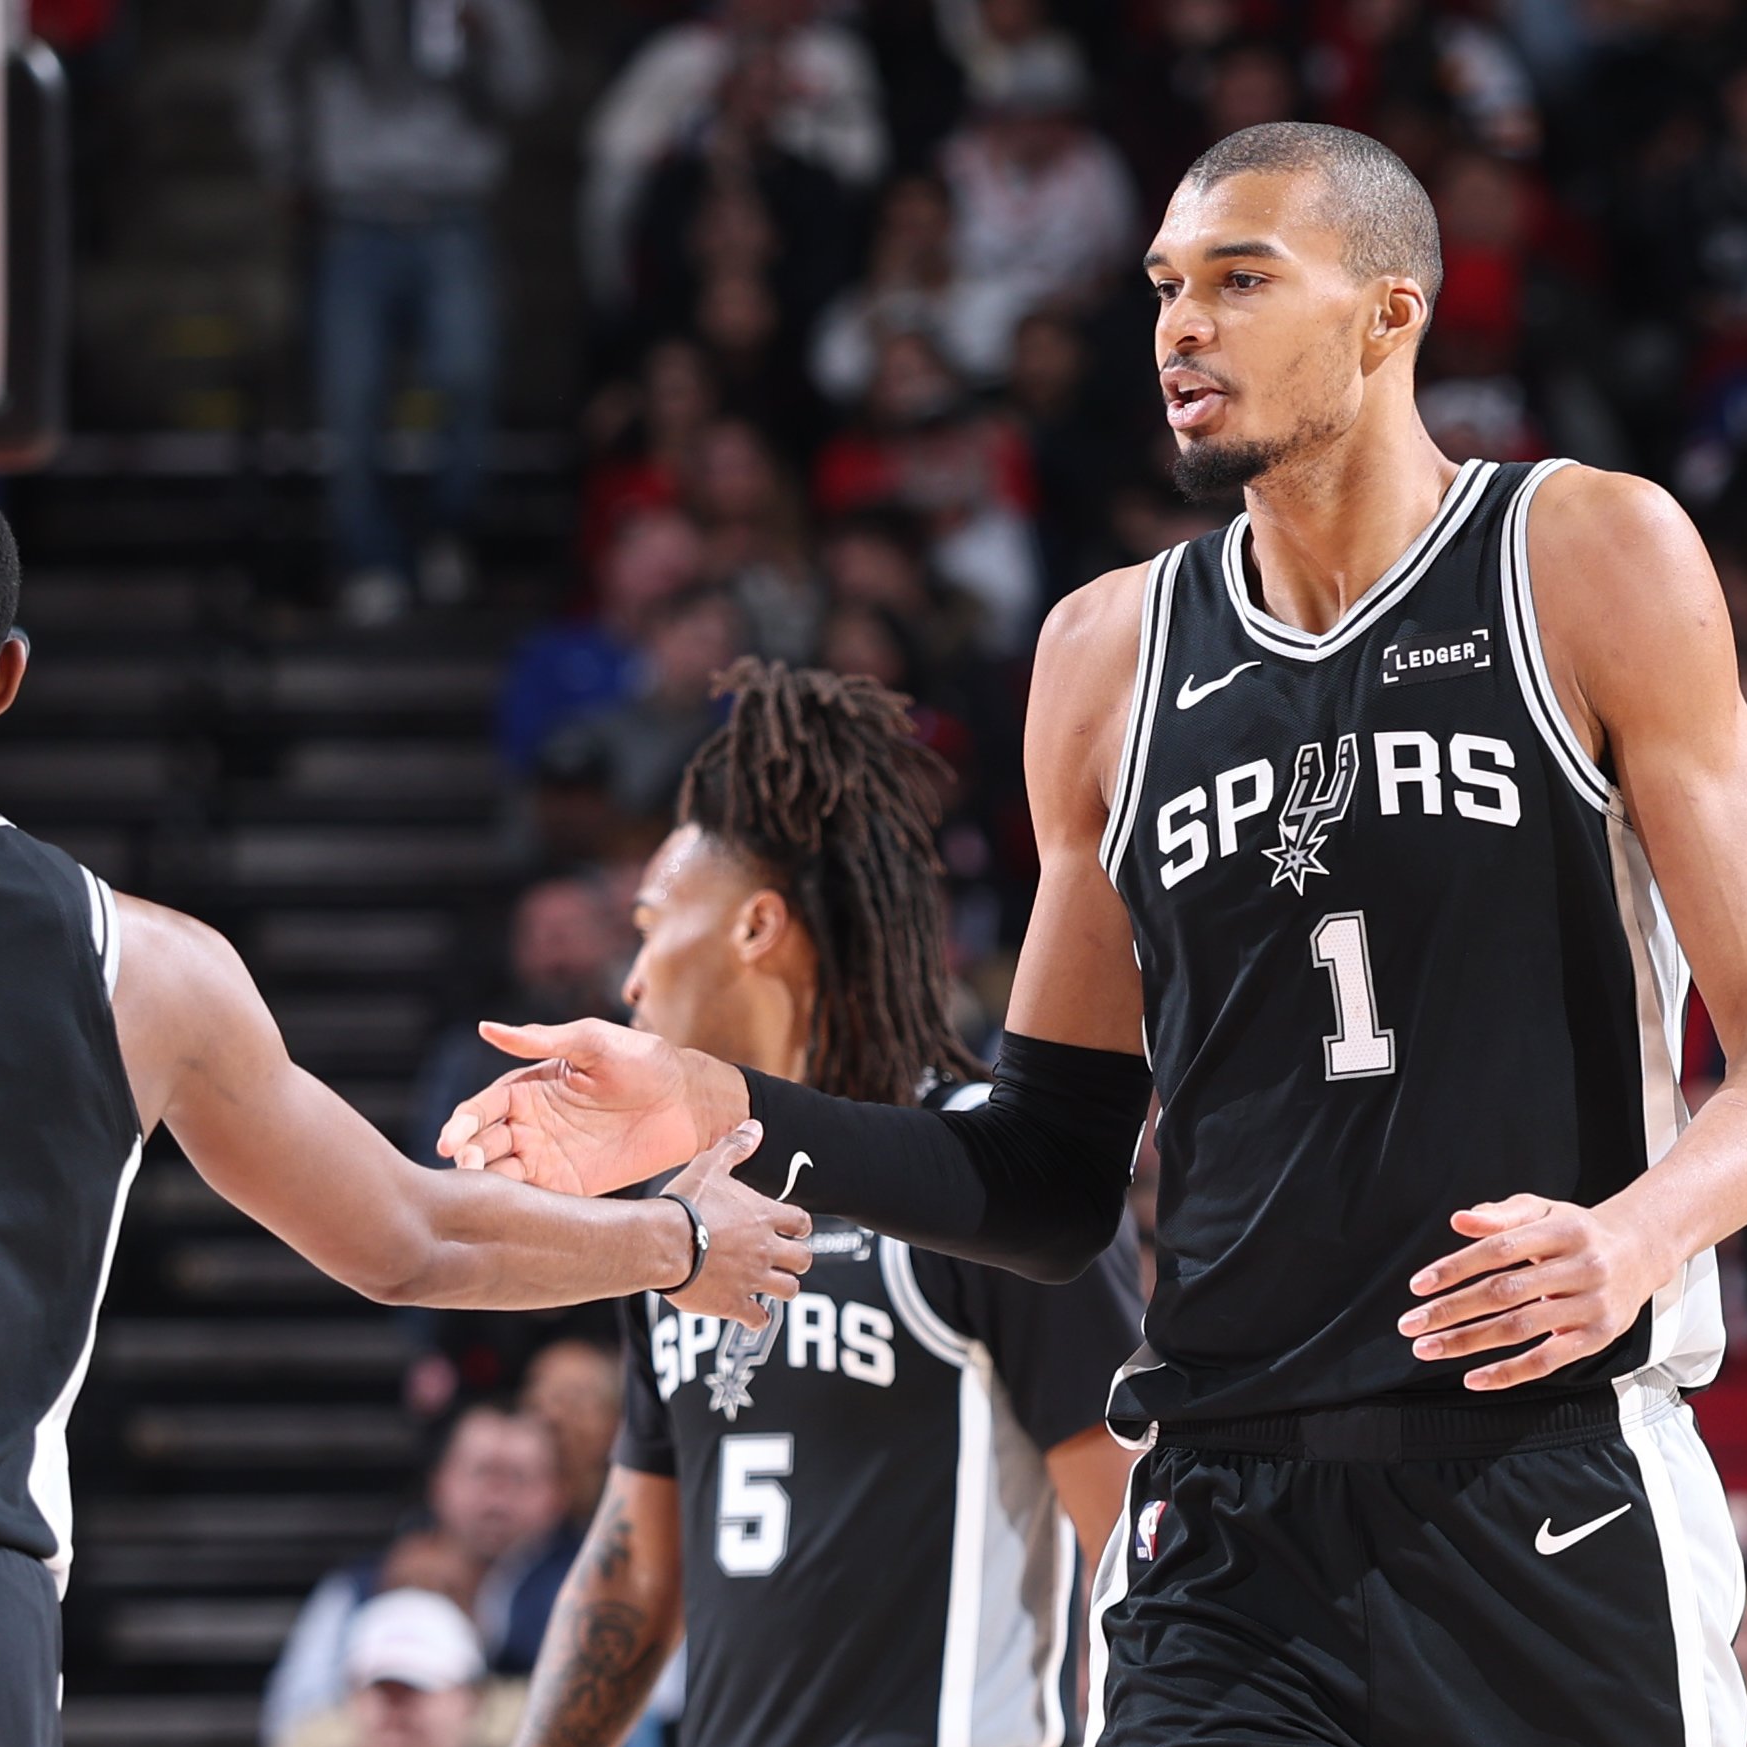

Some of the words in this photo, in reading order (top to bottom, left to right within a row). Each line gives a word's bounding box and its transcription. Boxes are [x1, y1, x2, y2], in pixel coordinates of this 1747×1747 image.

[1395, 642, 1475, 671] LEDGER
[1156, 731, 1521, 896] SPURS
[1309, 910, 1396, 1082] 1
[714, 1432, 795, 1578] 5
